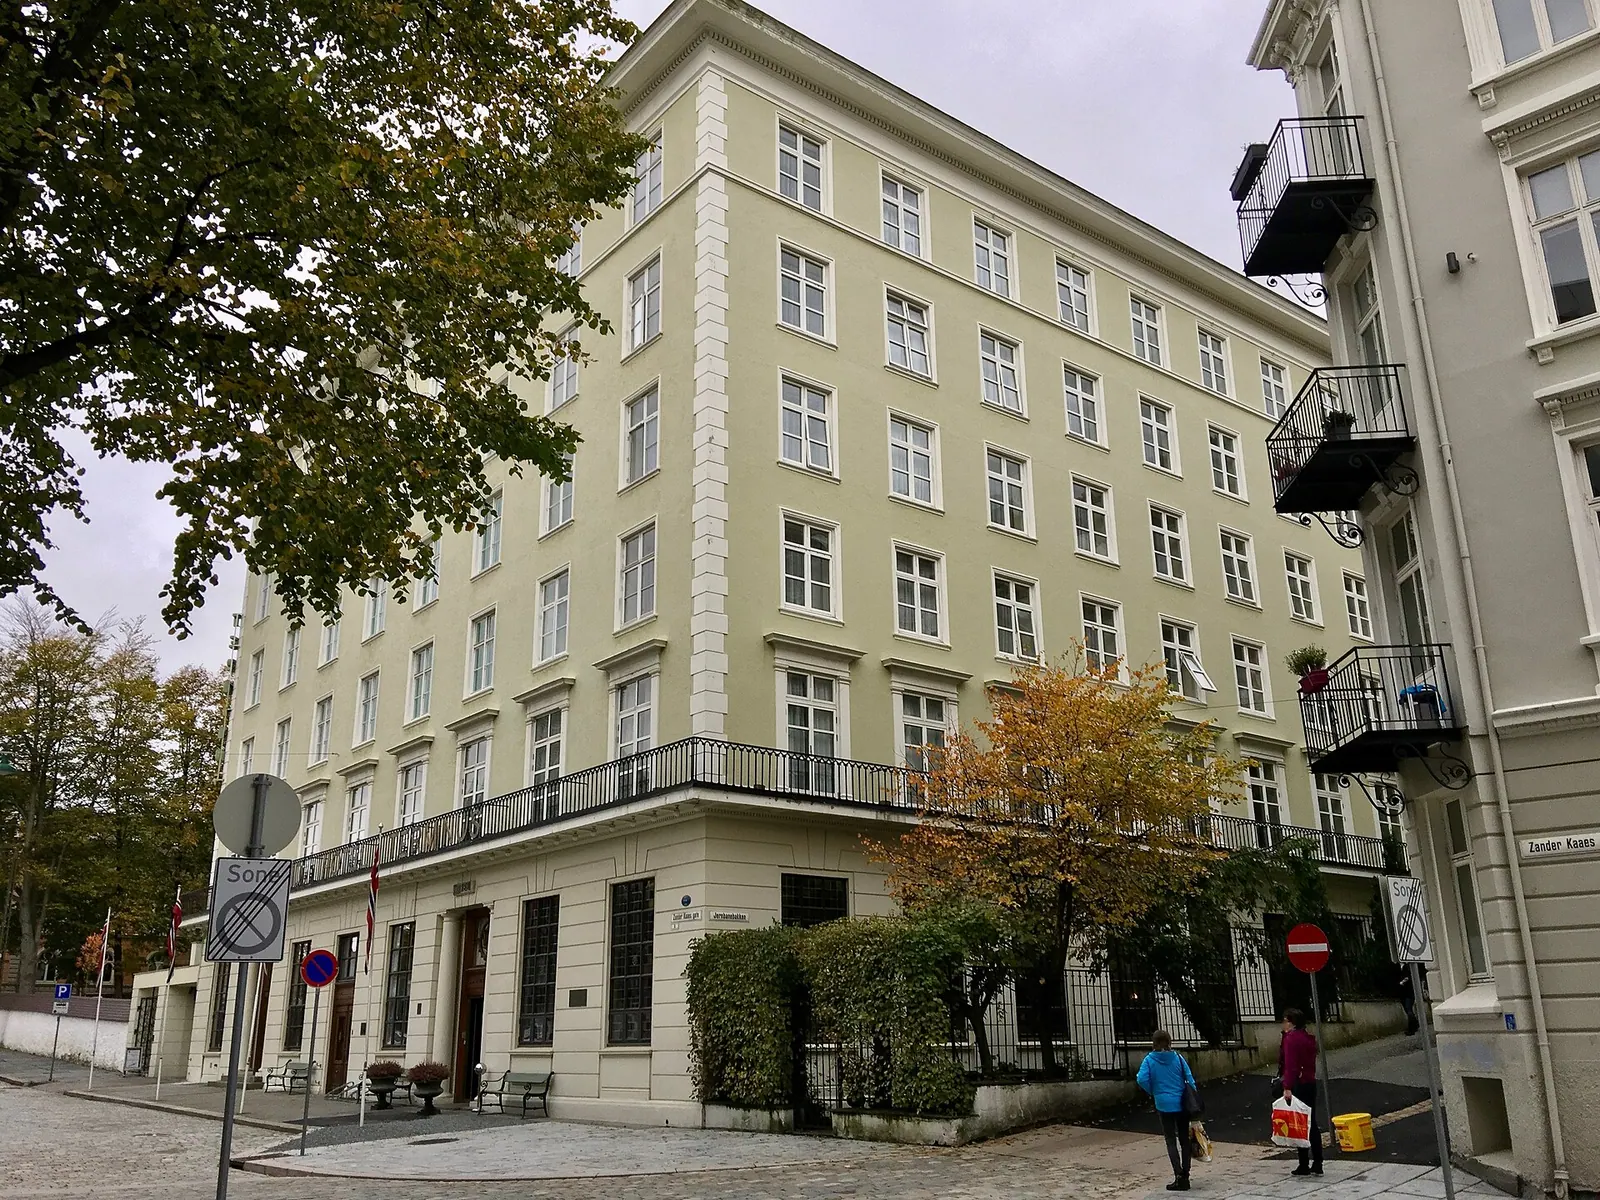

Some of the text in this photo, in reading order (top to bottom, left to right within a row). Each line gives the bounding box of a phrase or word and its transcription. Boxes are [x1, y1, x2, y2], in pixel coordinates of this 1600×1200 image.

[1529, 838, 1596, 853] Zander Kaaes
[227, 864, 281, 883] Sone
[58, 985, 68, 998] P
